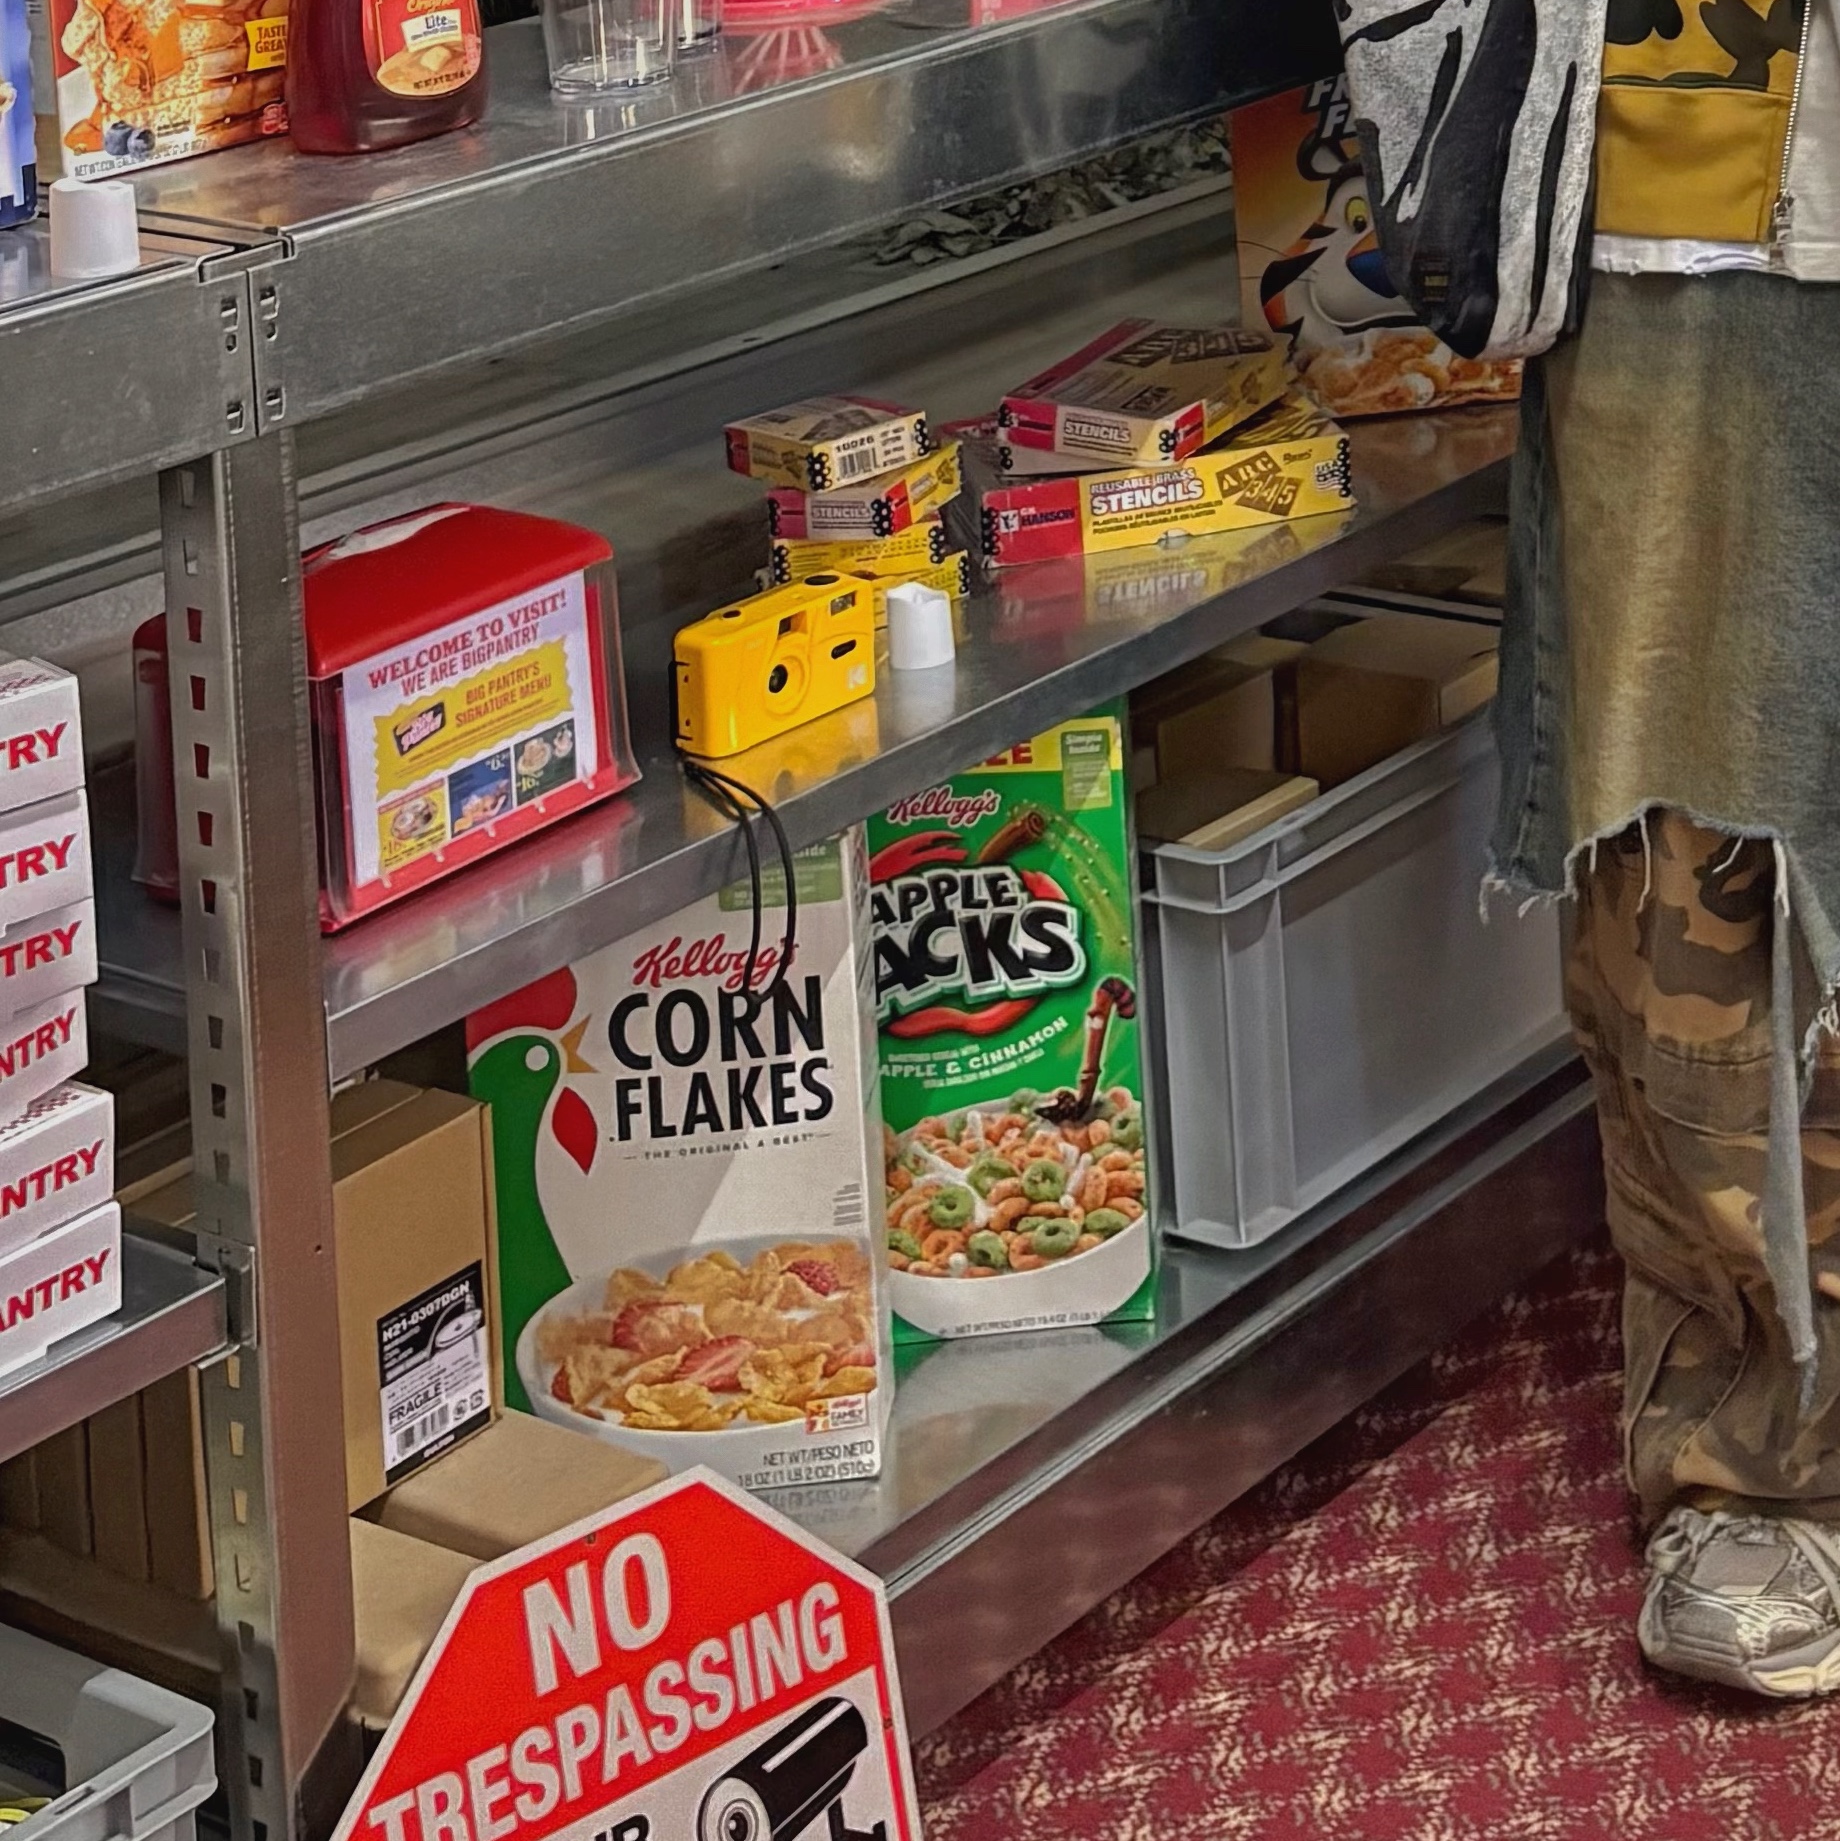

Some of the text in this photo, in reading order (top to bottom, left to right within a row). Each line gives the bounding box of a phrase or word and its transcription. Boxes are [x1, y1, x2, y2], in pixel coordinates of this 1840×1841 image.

[425, 14, 448, 30] Lite
[835, 434, 875, 454] 10026
[1064, 421, 1132, 444] STENCILS
[1091, 475, 1152, 495] REUSABLE
[1091, 479, 1205, 516] STENCILS
[811, 506, 872, 520] STENCILS
[368, 588, 567, 689] WELCOME TO VISIT!
[401, 621, 540, 697] WE ARE BIGPANTRY
[887, 784, 1000, 826] Kellogg's
[871, 868, 1018, 924] APPLE
[0, 920, 82, 978] TRY
[873, 906, 1077, 1007] ACKS
[608, 974, 825, 1072] CORN
[878, 1063, 938, 1078] APPLE
[945, 1059, 962, 1075] &
[969, 1016, 1069, 1071] CINNAMON
[614, 1057, 834, 1143] FLAKES
[645, 1149, 671, 1161] THE
[678, 1139, 749, 1158] ORIGINAL
[389, 1381, 442, 1426] FRAGILE
[763, 1452, 786, 1467] NET
[842, 1439, 875, 1458] NETO
[521, 1531, 672, 1698] NO
[366, 1580, 849, 1841] TRESPASSING
